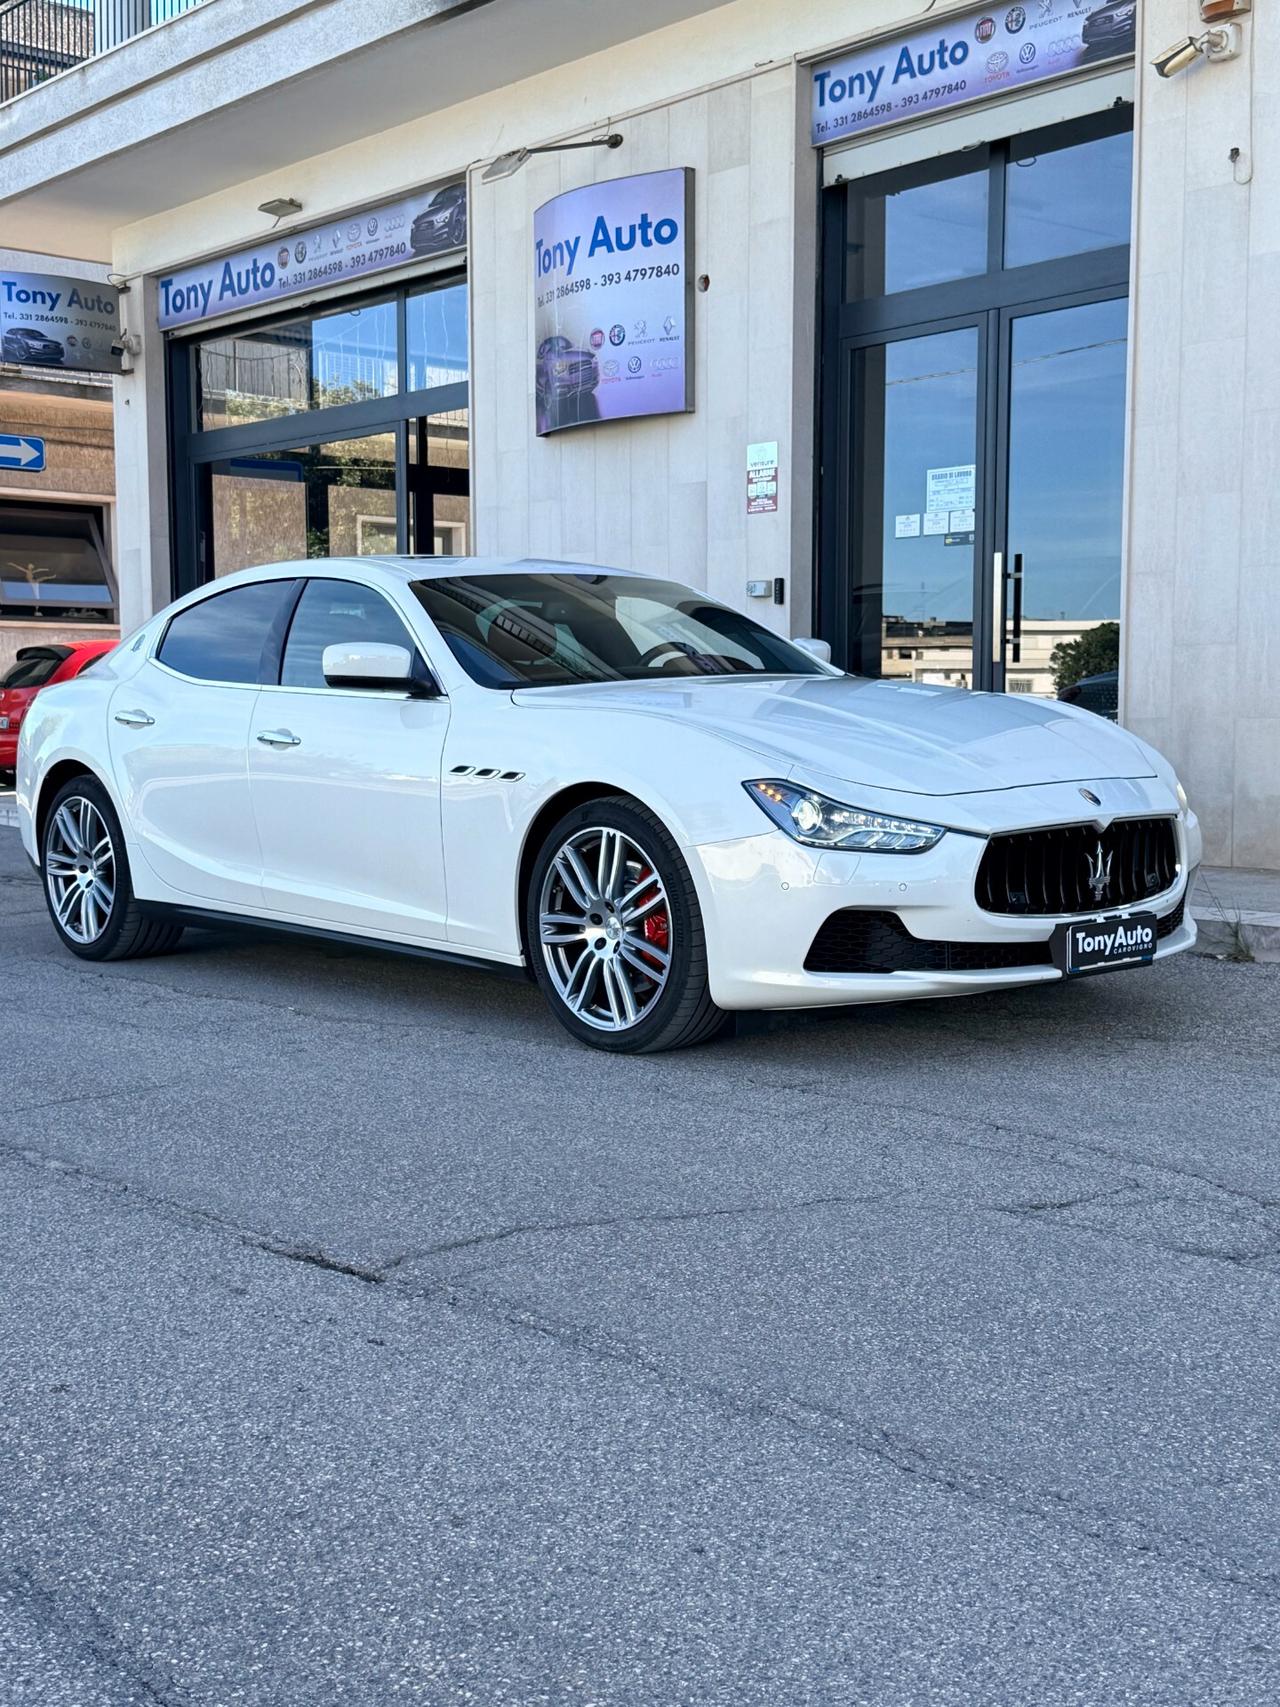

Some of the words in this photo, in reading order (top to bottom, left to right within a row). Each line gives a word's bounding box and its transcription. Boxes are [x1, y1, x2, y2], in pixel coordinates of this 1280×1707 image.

[814, 70, 886, 107] Tony
[892, 39, 969, 85] Auto
[816, 122, 831, 134] Tel.
[833, 115, 849, 129] 331
[851, 102, 893, 124] 2864598
[901, 94, 920, 109] 393
[921, 80, 967, 102] 4797840
[278, 276, 291, 290] Tel.
[292, 271, 306, 286] 331
[307, 260, 344, 281] 2864598
[350, 253, 366, 269] 393
[367, 241, 407, 262] 4797840
[536, 235, 582, 278] Tony
[588, 213, 679, 258] Auto
[2, 281, 62, 312] Tony
[67, 287, 116, 315] Auto
[161, 278, 214, 317] Tony
[218, 258, 276, 301] Auto
[556, 278, 592, 300] 2864598
[600, 272, 622, 288] 393
[624, 263, 681, 282] 4797840
[4, 311, 18, 321] Tel.
[20, 313, 33, 321] 331
[35, 315, 69, 324] 2864598
[1076, 925, 1153, 956] TonyAuto
[1114, 942, 1153, 955] CAROVIGNO
